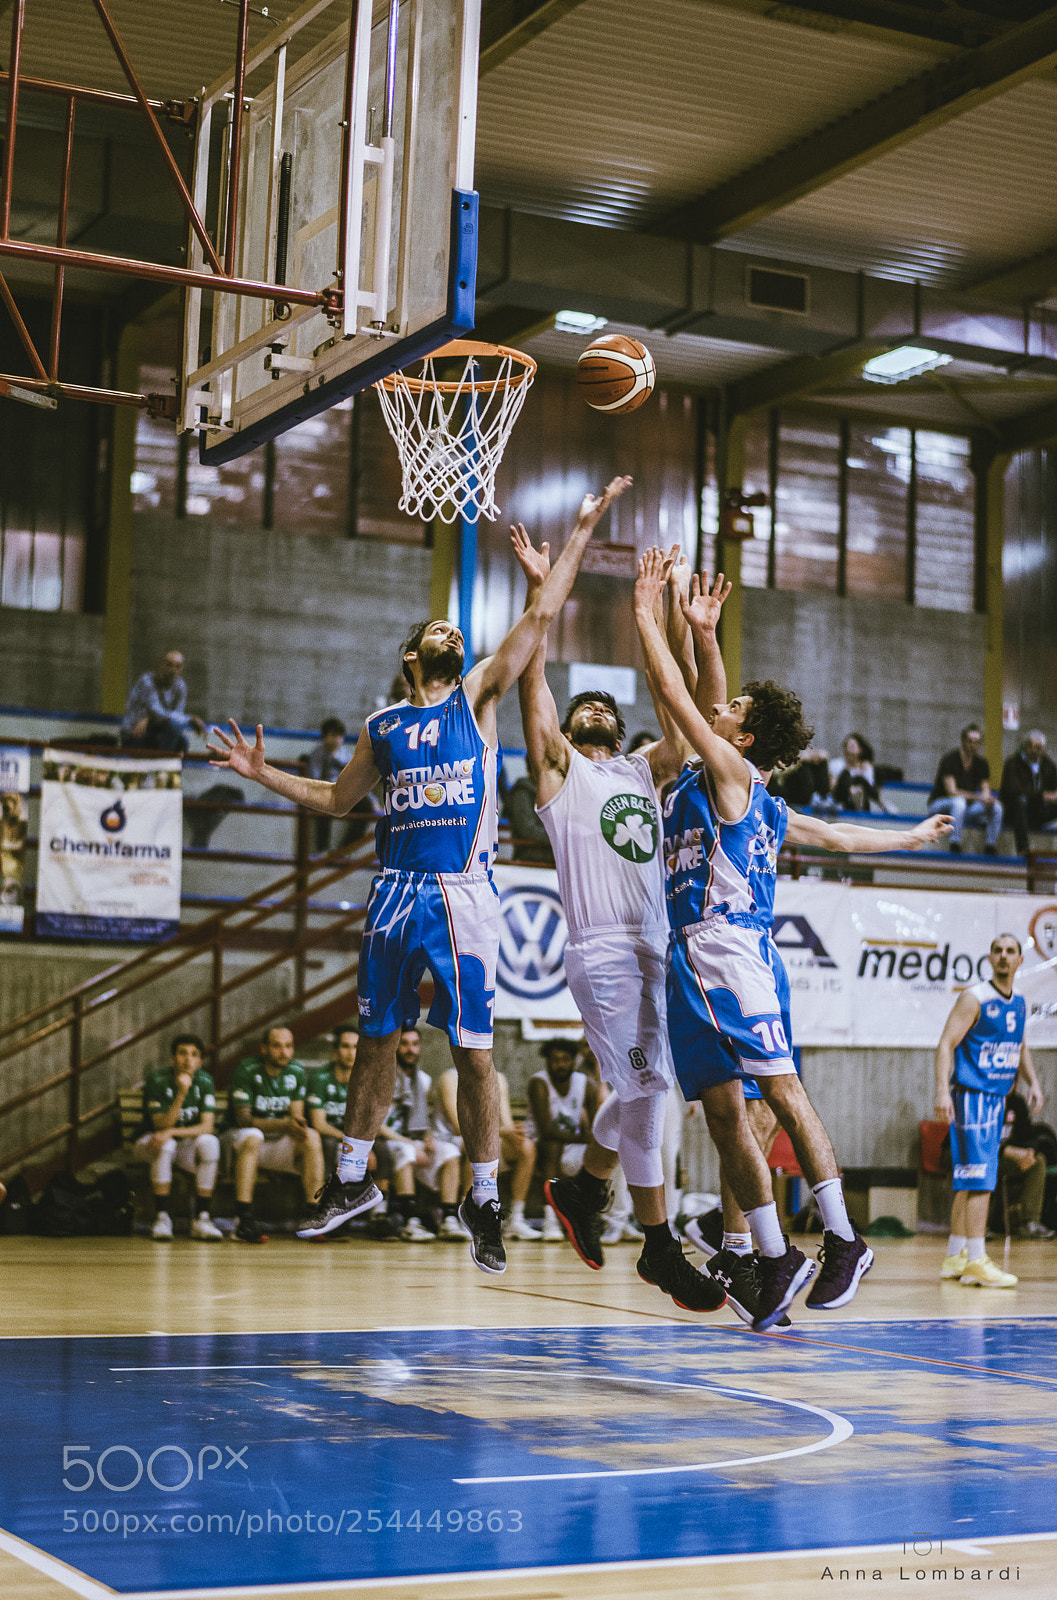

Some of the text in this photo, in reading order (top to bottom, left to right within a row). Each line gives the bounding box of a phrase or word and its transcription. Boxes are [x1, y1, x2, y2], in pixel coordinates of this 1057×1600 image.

[404, 718, 441, 750] 14
[602, 795, 630, 822] GREEN
[49, 835, 171, 859] chemifarma
[1006, 1010, 1017, 1034] 5
[751, 1019, 789, 1053] 10
[628, 1046, 648, 1070] 8
